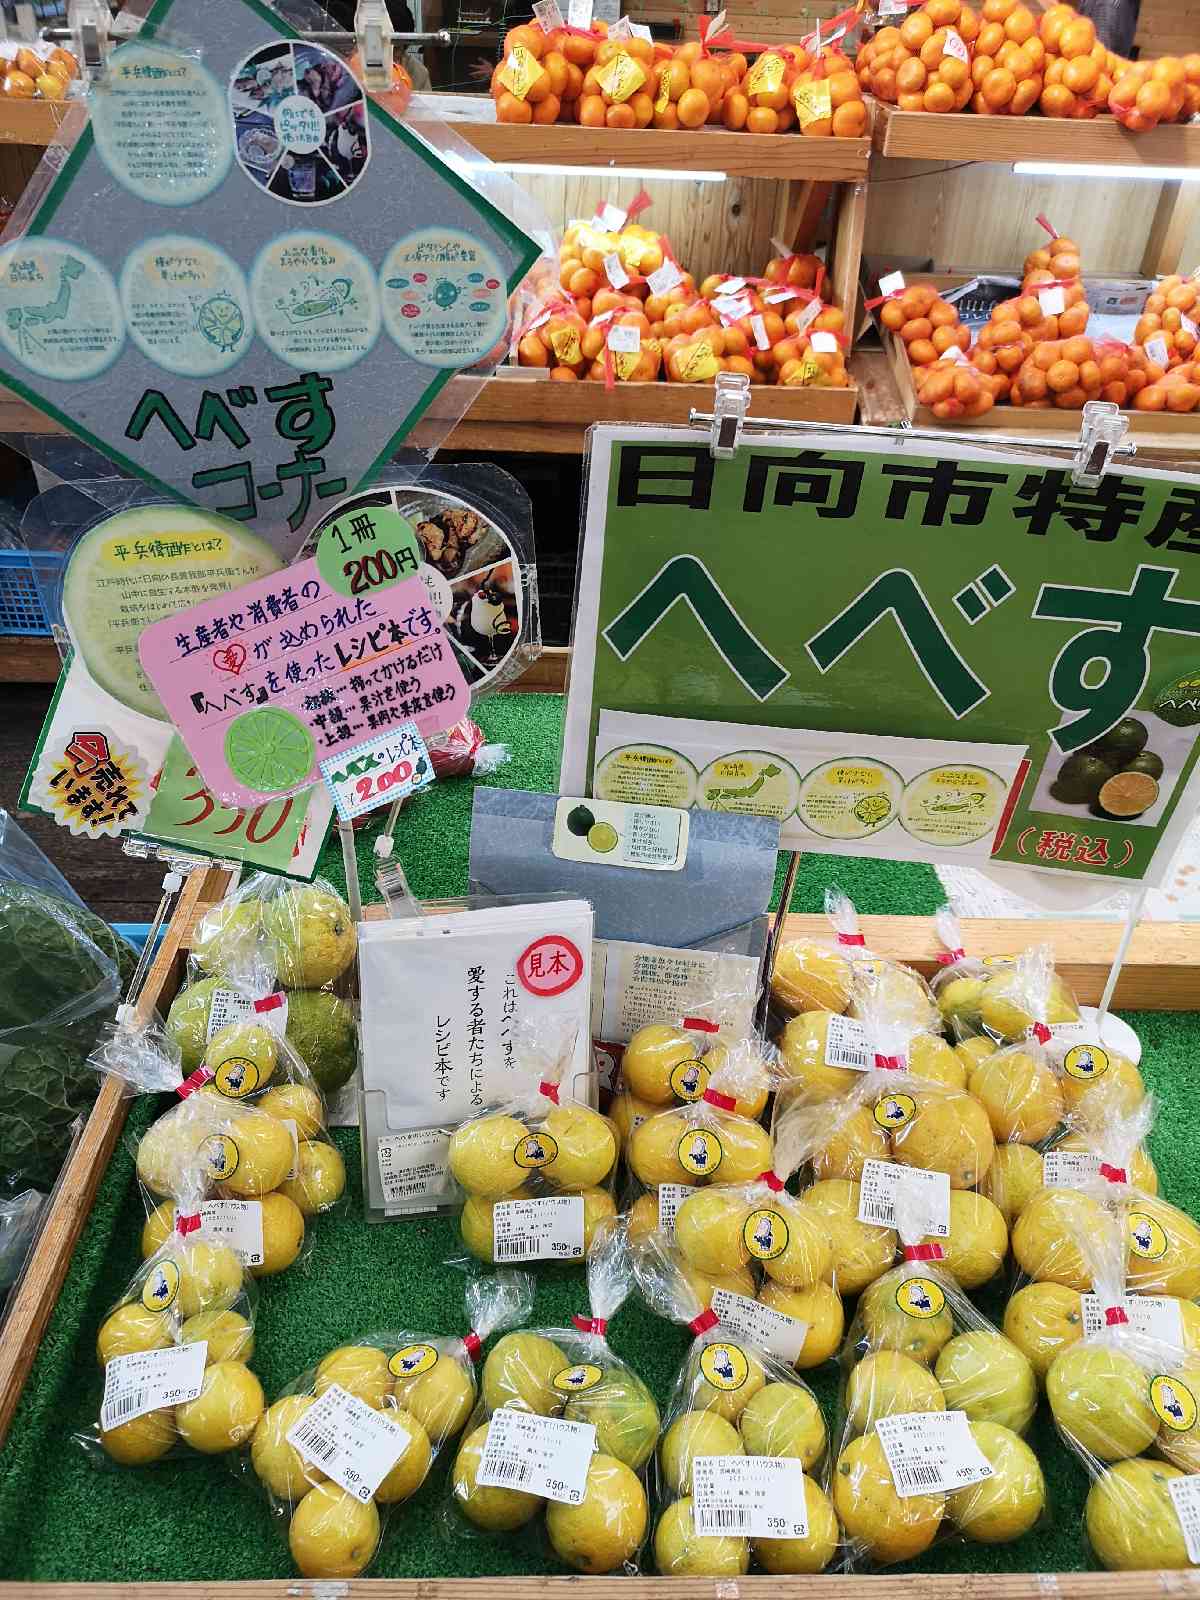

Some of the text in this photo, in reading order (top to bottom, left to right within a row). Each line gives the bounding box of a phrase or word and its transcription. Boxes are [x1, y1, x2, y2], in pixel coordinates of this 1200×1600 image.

[125, 372, 336, 453] へべす
[192, 450, 347, 533] コーナー
[331, 513, 376, 553] 1冊
[344, 545, 419, 595] 200円
[175, 580, 320, 658] 生産者や消費者の
[253, 598, 377, 660] が込められた
[601, 553, 1200, 755] へべす
[527, 950, 570, 979] 見本
[433, 1016, 454, 1102] レシピ本です
[466, 965, 486, 1106] 愛する者たちによる
